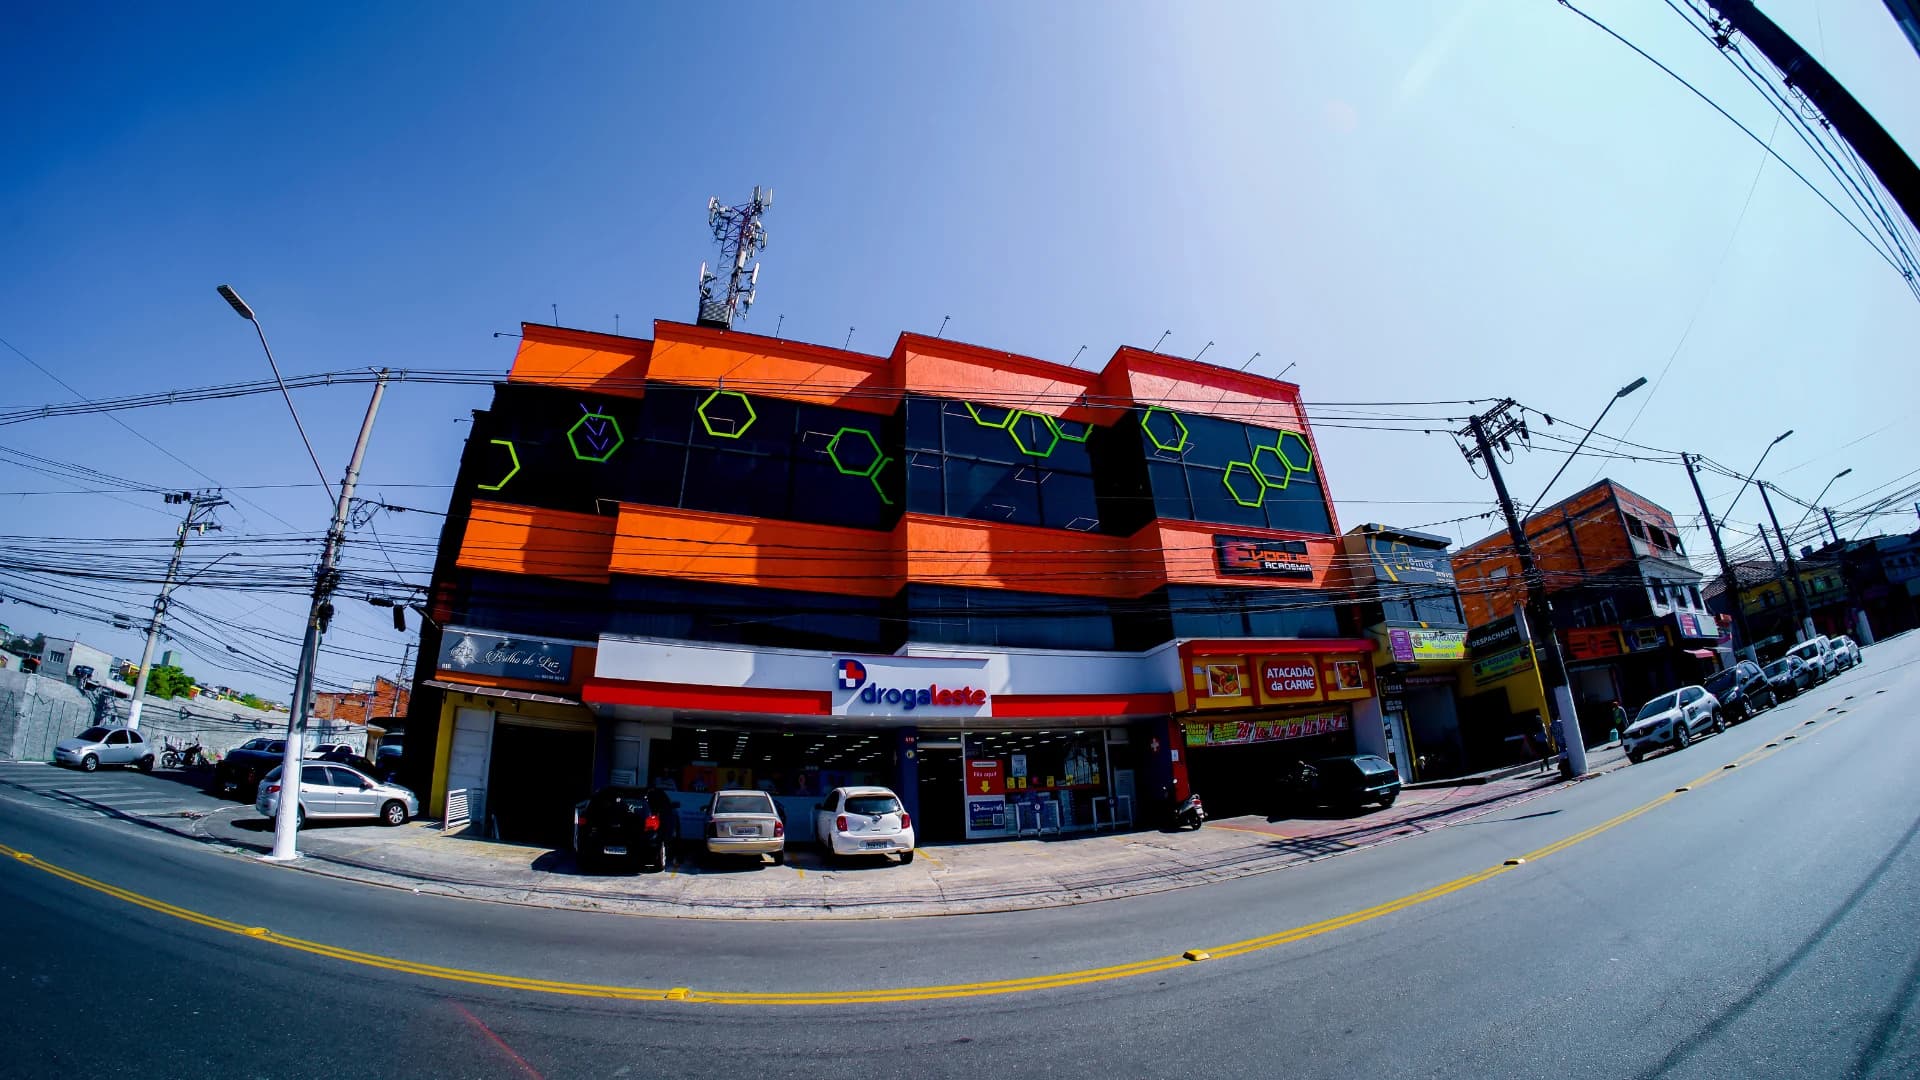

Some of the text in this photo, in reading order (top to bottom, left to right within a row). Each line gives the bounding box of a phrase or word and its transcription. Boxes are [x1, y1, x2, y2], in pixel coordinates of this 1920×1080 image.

[1471, 626, 1518, 648] DESPACHANTE
[484, 650, 561, 674] Brilho de Luz
[1267, 665, 1315, 679] ATACADÃO
[860, 682, 987, 711] drogaleste
[1271, 680, 1315, 691] da CARNE
